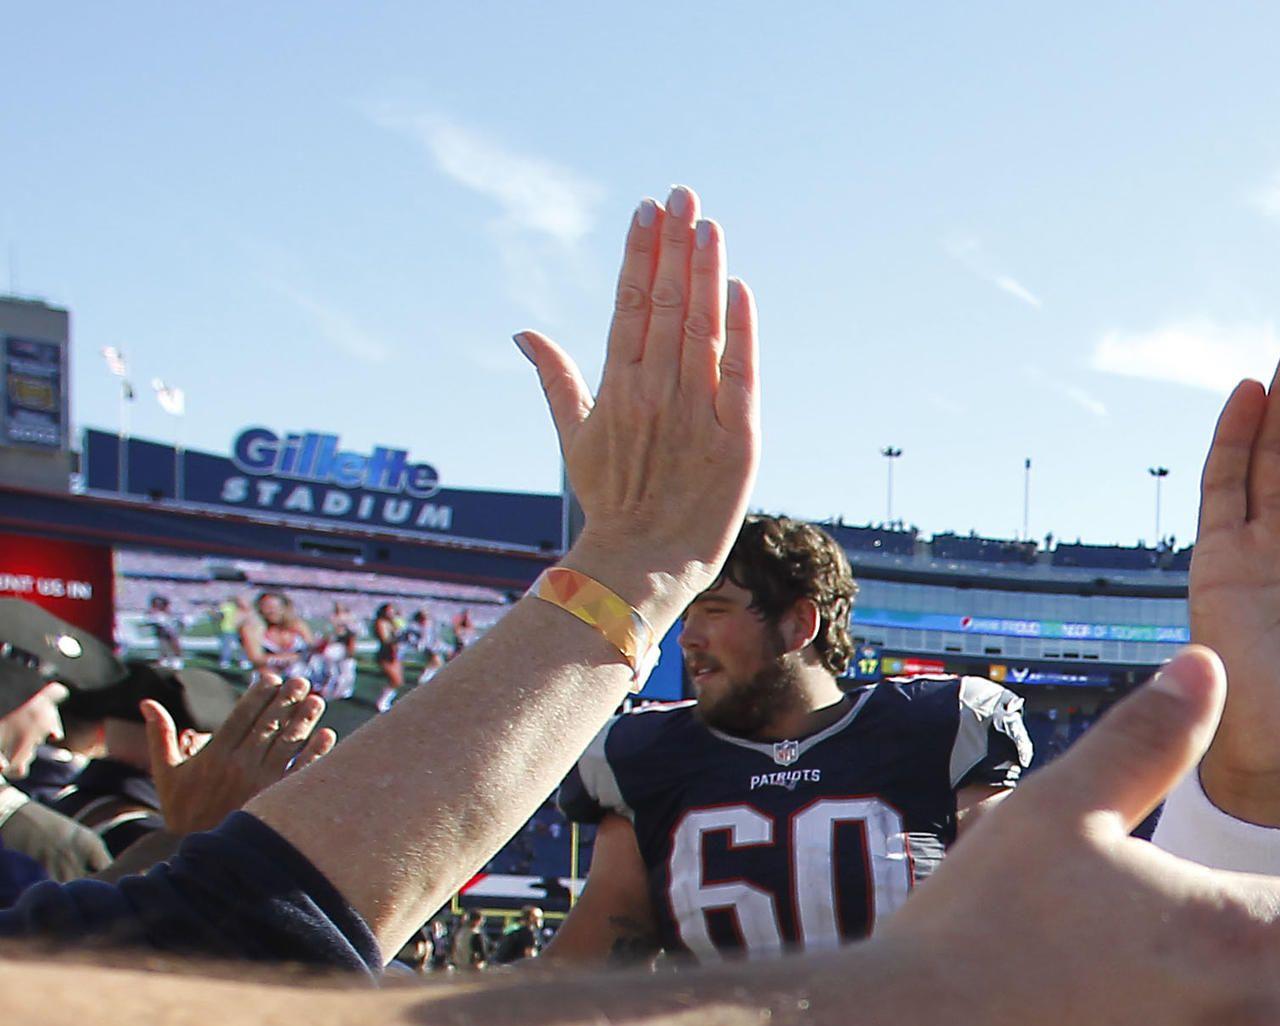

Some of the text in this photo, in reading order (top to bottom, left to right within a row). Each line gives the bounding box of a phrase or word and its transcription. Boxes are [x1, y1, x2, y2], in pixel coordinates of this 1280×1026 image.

[233, 426, 440, 499] Gillette
[221, 476, 453, 530] STADIUM
[750, 769, 821, 790] PATRIOTS
[666, 794, 915, 962] 60
